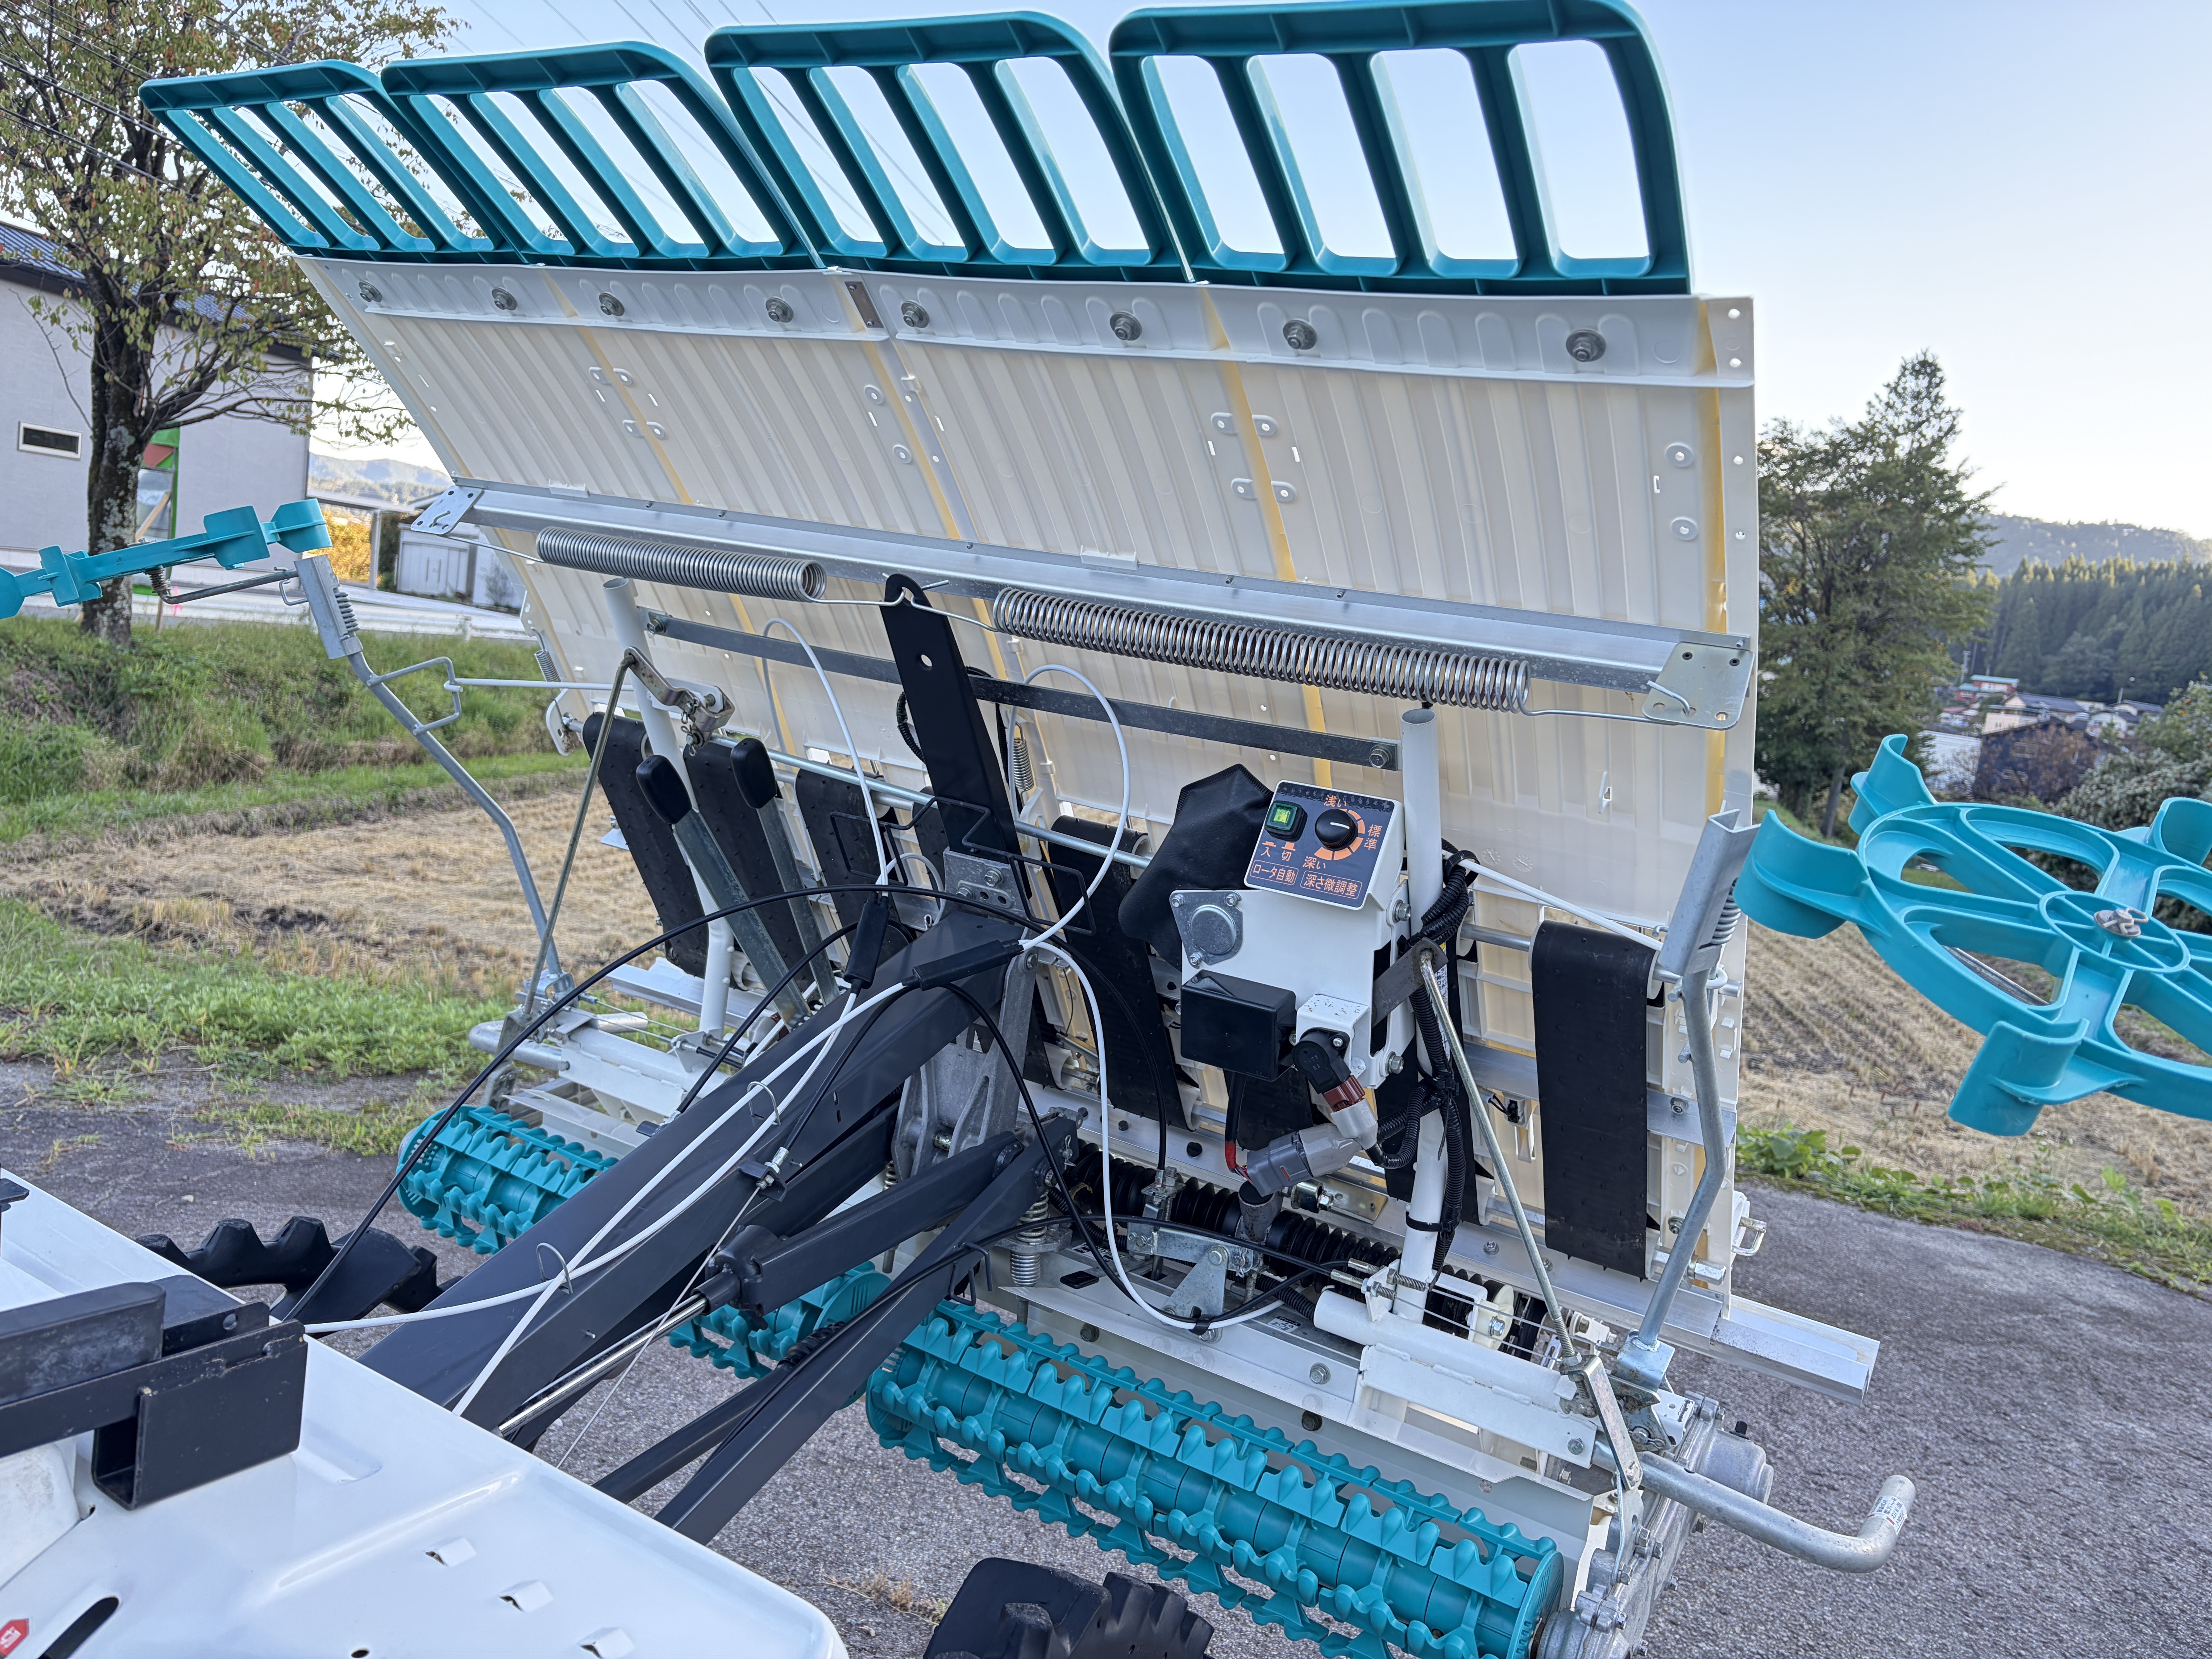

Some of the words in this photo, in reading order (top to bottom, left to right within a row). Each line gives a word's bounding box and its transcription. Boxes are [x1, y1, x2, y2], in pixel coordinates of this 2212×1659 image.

[1323, 795, 1347, 807] 浅い
[1364, 824, 1382, 850] 標準
[1261, 847, 1270, 857] 入
[1281, 850, 1292, 861] 切
[1302, 856, 1326, 869] 深い
[1253, 864, 1295, 883] ロータ自動
[1304, 874, 1358, 896] 深さ微調整
